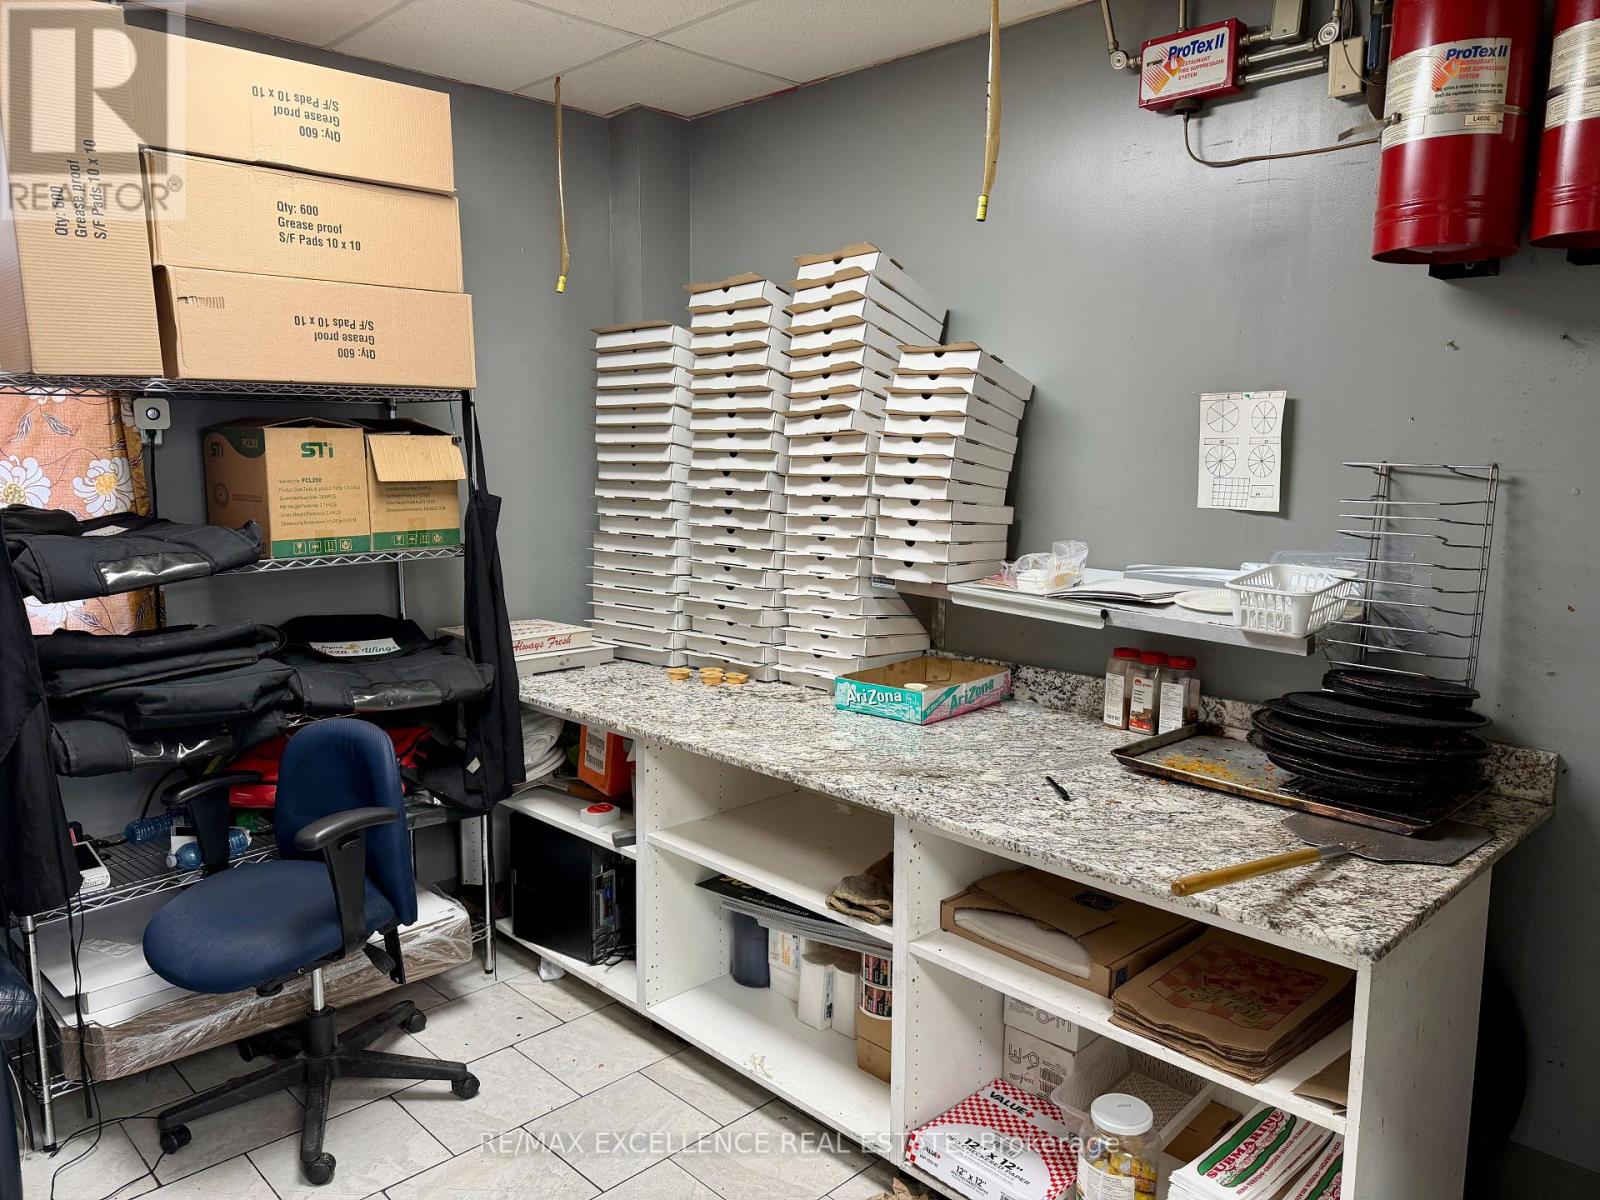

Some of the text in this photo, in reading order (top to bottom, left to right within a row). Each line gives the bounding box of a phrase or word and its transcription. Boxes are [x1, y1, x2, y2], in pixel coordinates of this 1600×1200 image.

[1168, 38, 1214, 60] ProTex
[1446, 46, 1498, 61] ProTex
[252, 85, 339, 112] S/F Pads 10 x 10
[273, 105, 340, 127] Grease proof
[299, 125, 341, 143] Qty: 600
[83, 139, 96, 153] 10
[86, 168, 100, 181] 10
[67, 160, 88, 238] Grease proof
[90, 187, 104, 217] Pads
[277, 200, 319, 216] Qty: 600
[51, 186, 70, 236] Qty: 600
[93, 219, 107, 240] S/F
[278, 216, 342, 235] Grease proof
[279, 232, 361, 251] S/F Pads 10 x 10
[294, 315, 374, 331] S/F Pads 10 x 10
[314, 331, 375, 345] Grease proof
[337, 347, 376, 360] Qty: 600
[512, 634, 572, 652] Always Fresh
[1206, 1110, 1285, 1179] SUBMARINE
